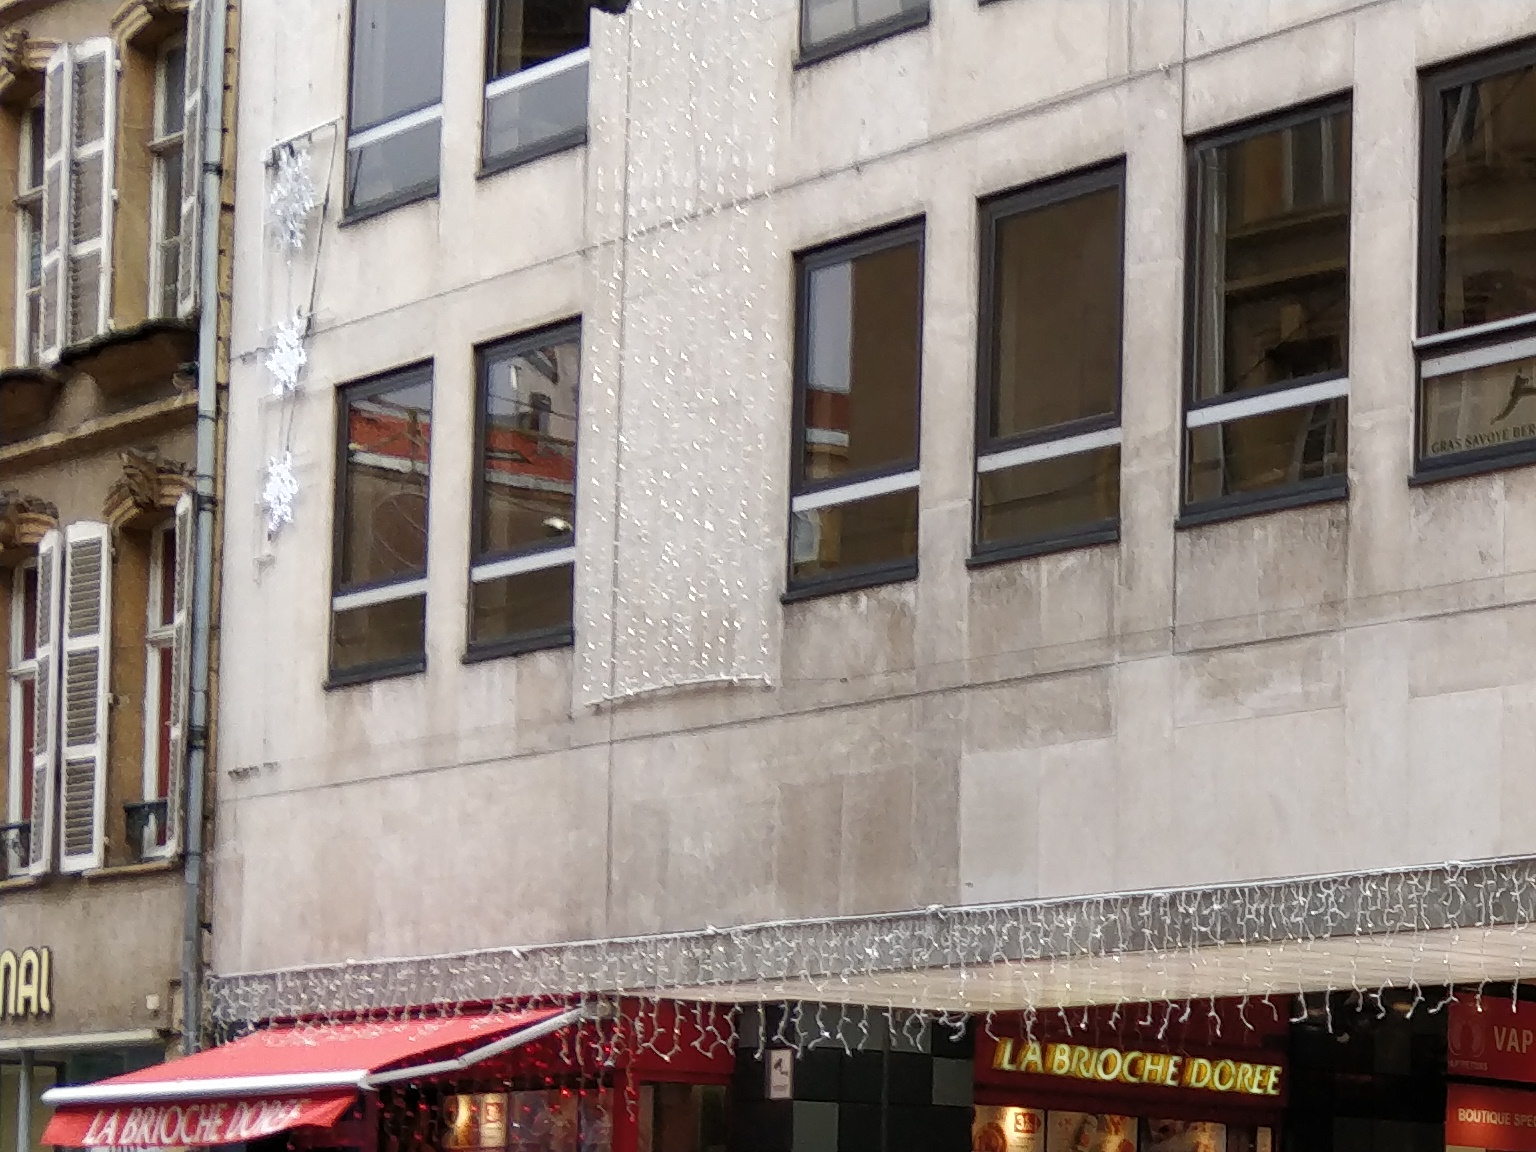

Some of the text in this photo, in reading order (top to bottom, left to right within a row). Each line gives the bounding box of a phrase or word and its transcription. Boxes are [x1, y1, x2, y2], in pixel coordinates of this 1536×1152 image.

[1432, 438, 1462, 454] GRAS
[1001, 1038, 1044, 1073] LA
[1051, 1043, 1181, 1087] BRIOCHE
[82, 1107, 118, 1146] LA
[118, 1101, 225, 1145] BRIOCHE
[1458, 1108, 1511, 1126] BOUTIQUE
